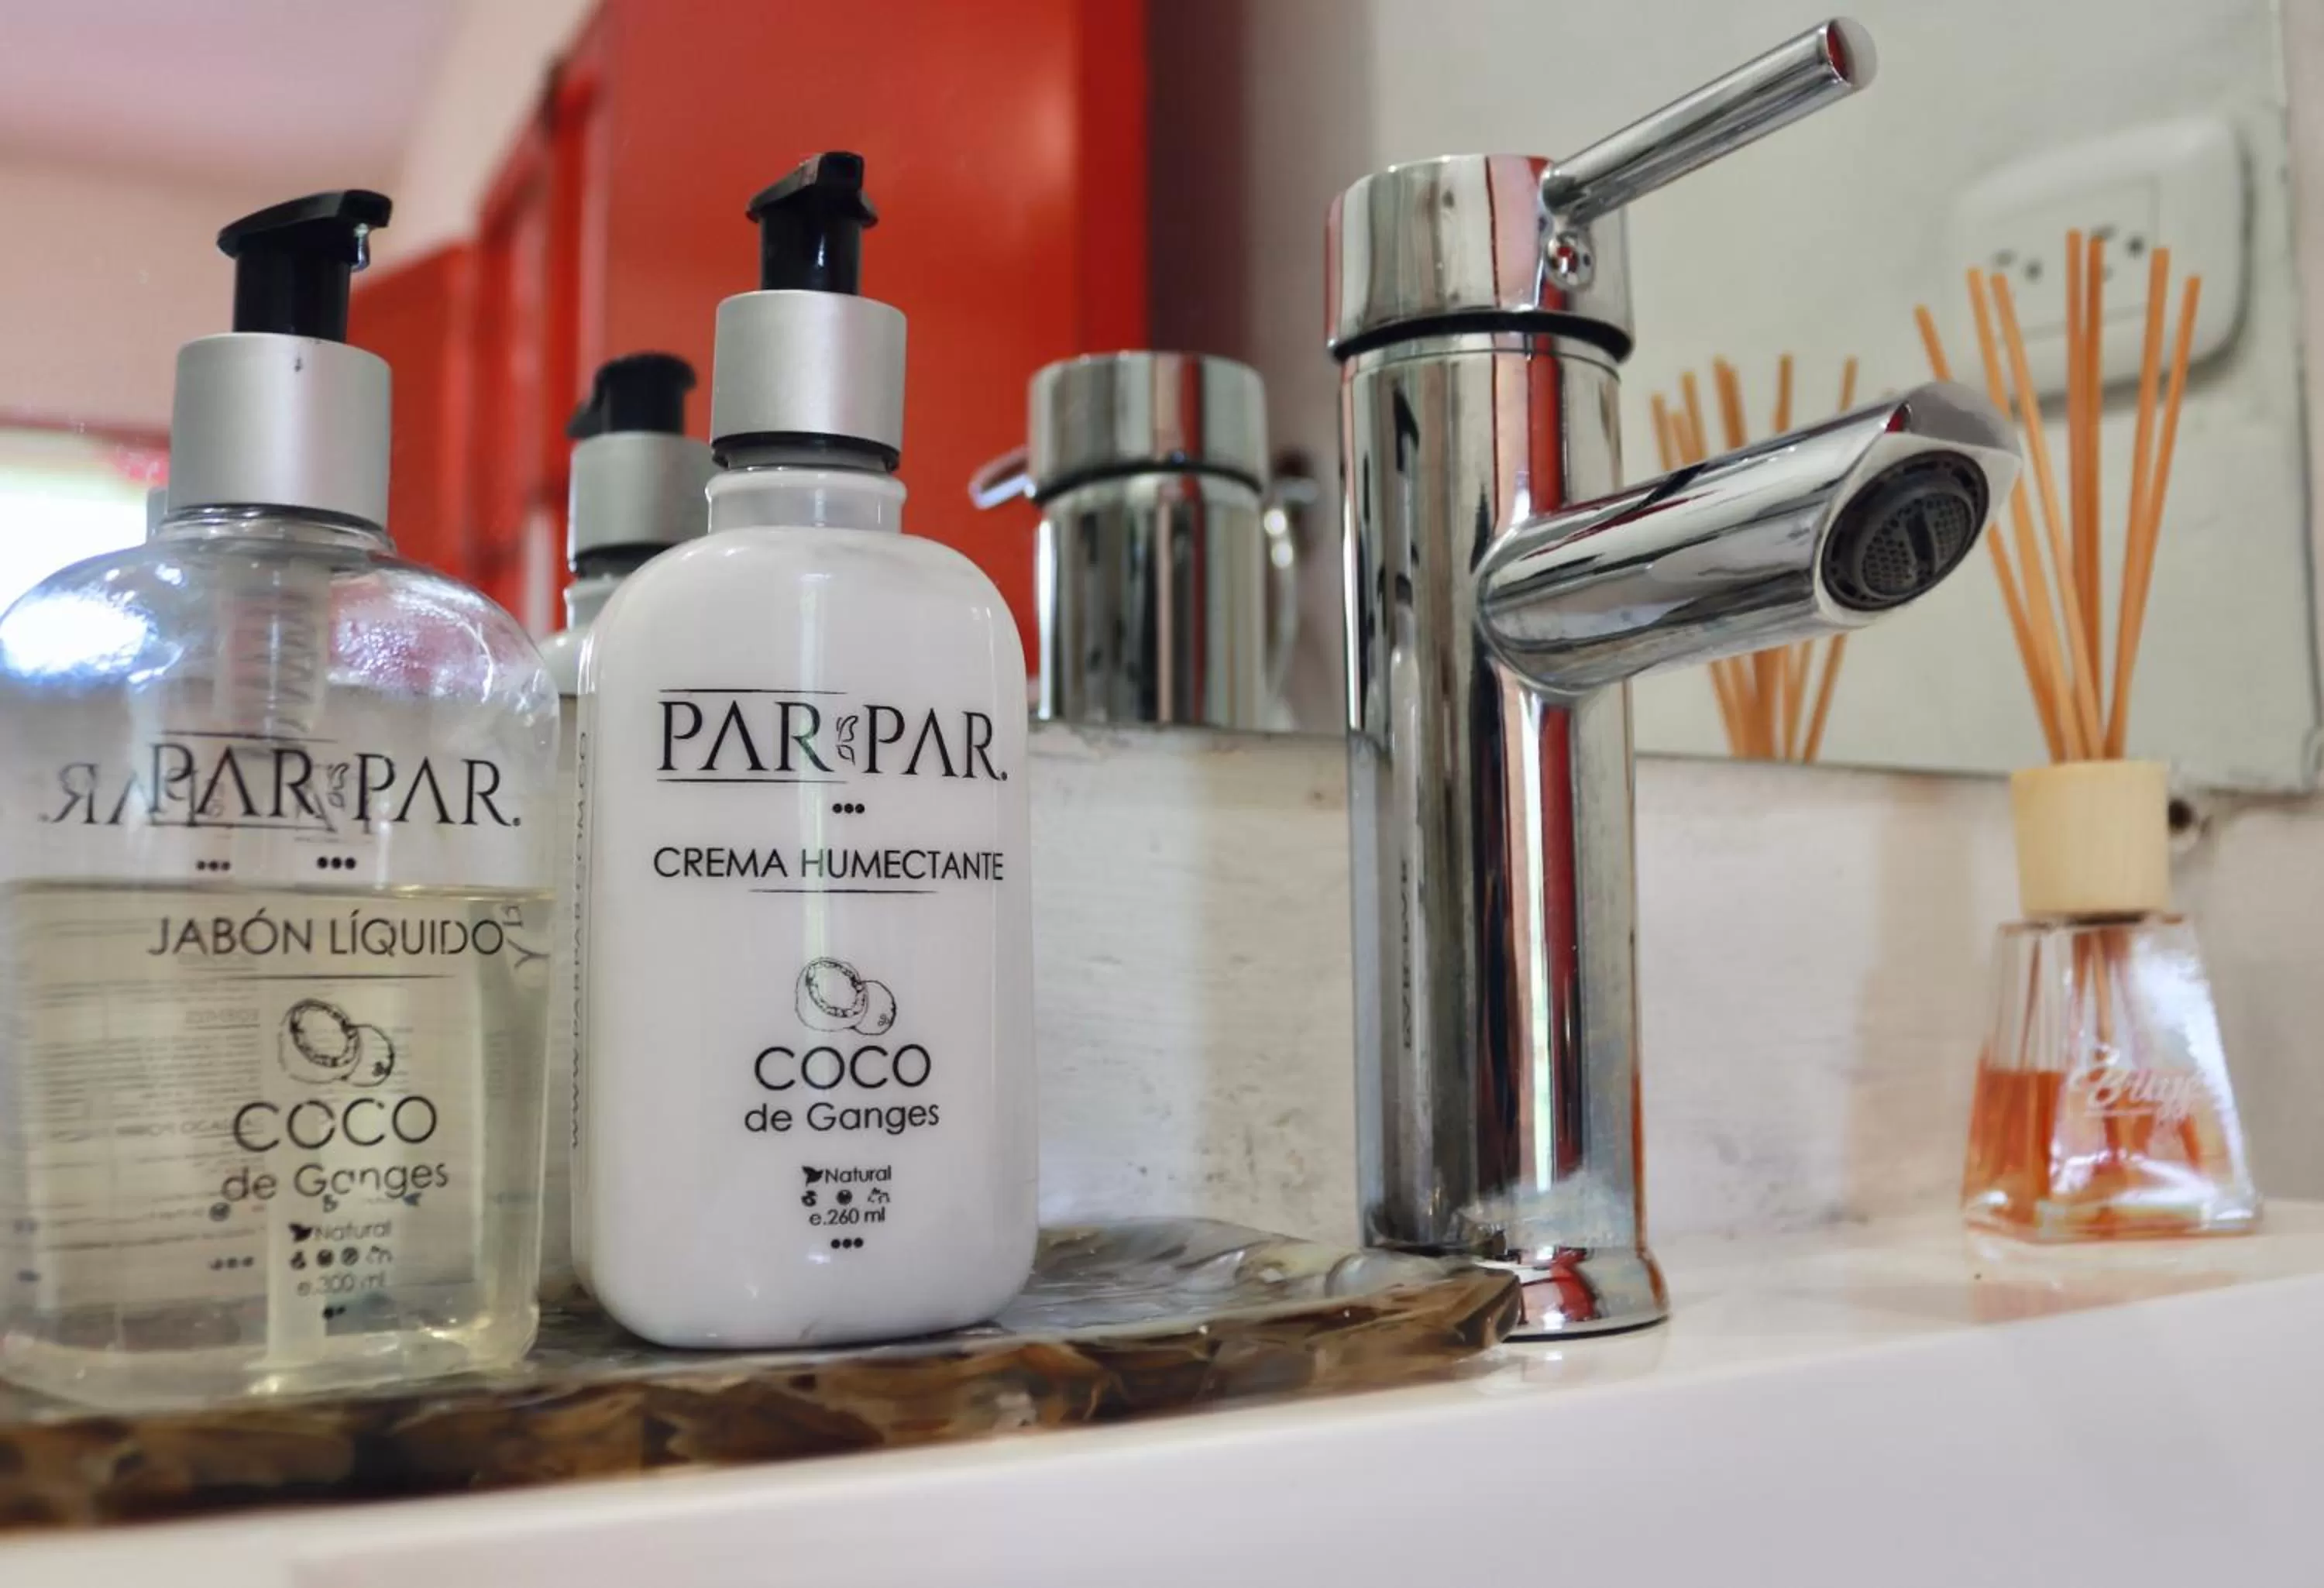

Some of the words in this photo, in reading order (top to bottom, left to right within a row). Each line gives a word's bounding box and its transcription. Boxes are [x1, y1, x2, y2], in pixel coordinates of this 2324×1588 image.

[657, 699, 834, 772] PAR
[147, 741, 317, 818] PAR
[653, 847, 789, 878] CREMA
[800, 848, 1004, 881] HUMECTANTE
[146, 907, 312, 956] JABÓN
[329, 909, 504, 957] LÍQUIDO
[754, 1043, 932, 1091] COCO
[233, 1095, 438, 1153] COCO
[744, 1102, 792, 1133] de
[806, 1102, 940, 1136] Ganges
[220, 1167, 277, 1202] de
[294, 1162, 449, 1199] Ganges
[824, 1164, 892, 1184] Natural
[313, 1219, 392, 1241] Natural
[864, 1205, 885, 1223] ml
